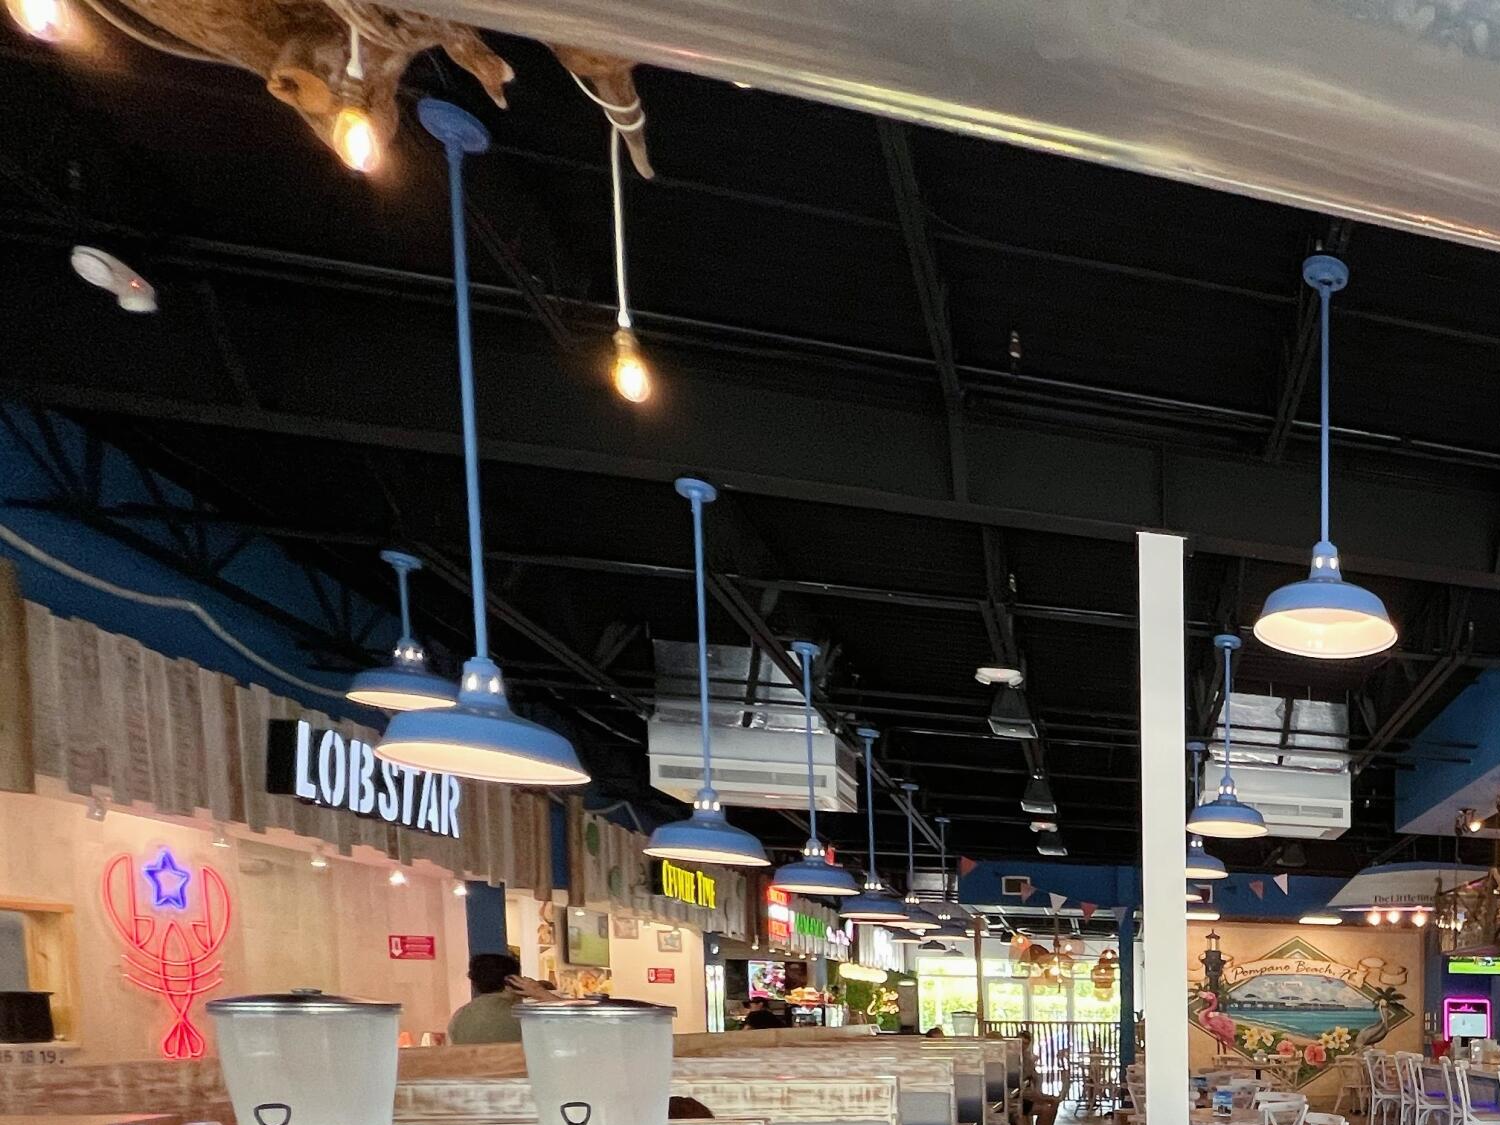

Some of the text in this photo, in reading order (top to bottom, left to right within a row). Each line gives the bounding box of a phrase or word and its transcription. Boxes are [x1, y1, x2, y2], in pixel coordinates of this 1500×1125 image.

[296, 720, 460, 838] LOBSTAR
[662, 859, 716, 909] CEVICHE TIME
[1232, 963, 1291, 980] Pompano
